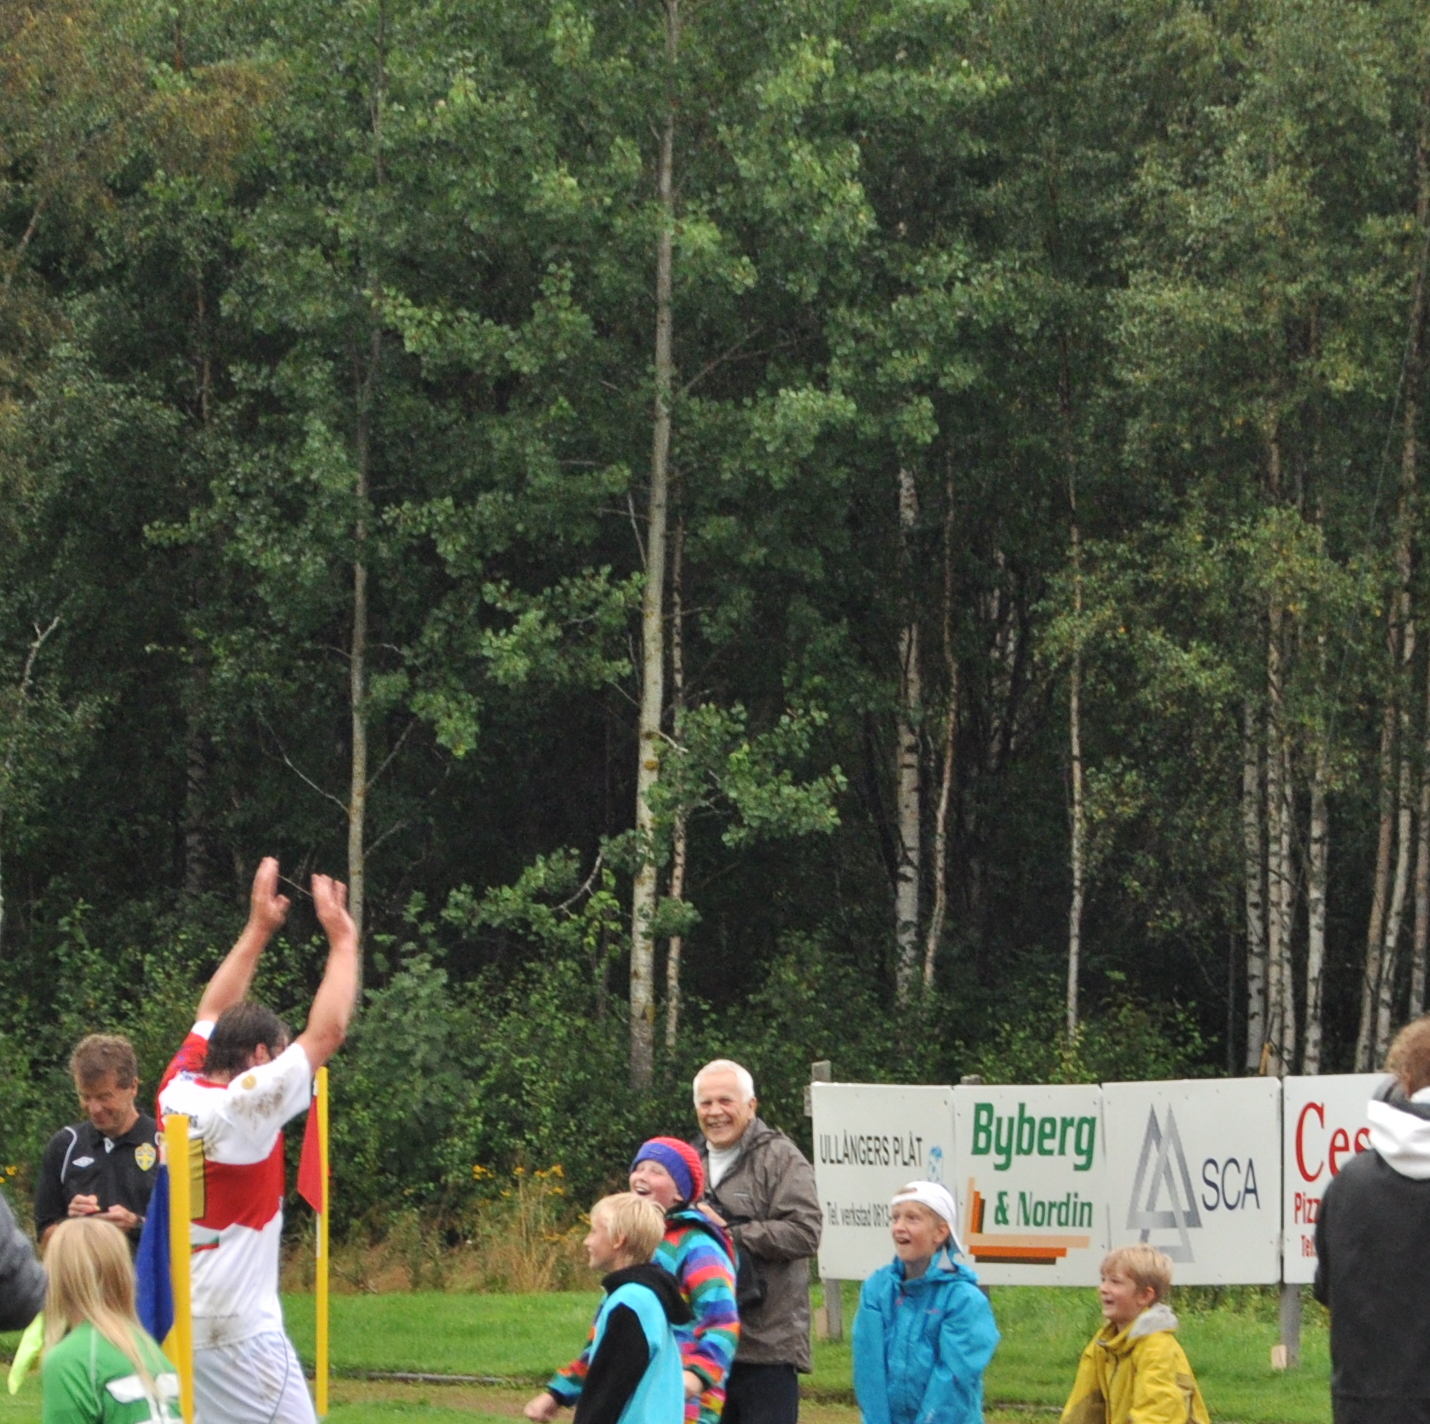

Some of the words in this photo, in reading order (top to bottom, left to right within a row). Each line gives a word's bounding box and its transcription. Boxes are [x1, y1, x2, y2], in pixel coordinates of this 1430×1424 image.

[819, 1129, 890, 1166] ULLÅNGERS
[892, 1130, 923, 1167] PLÅT
[971, 1102, 1097, 1171] Byberg
[1202, 1158, 1261, 1211] SCA
[994, 1190, 1009, 1226] &
[1016, 1191, 1094, 1228] Nordin
